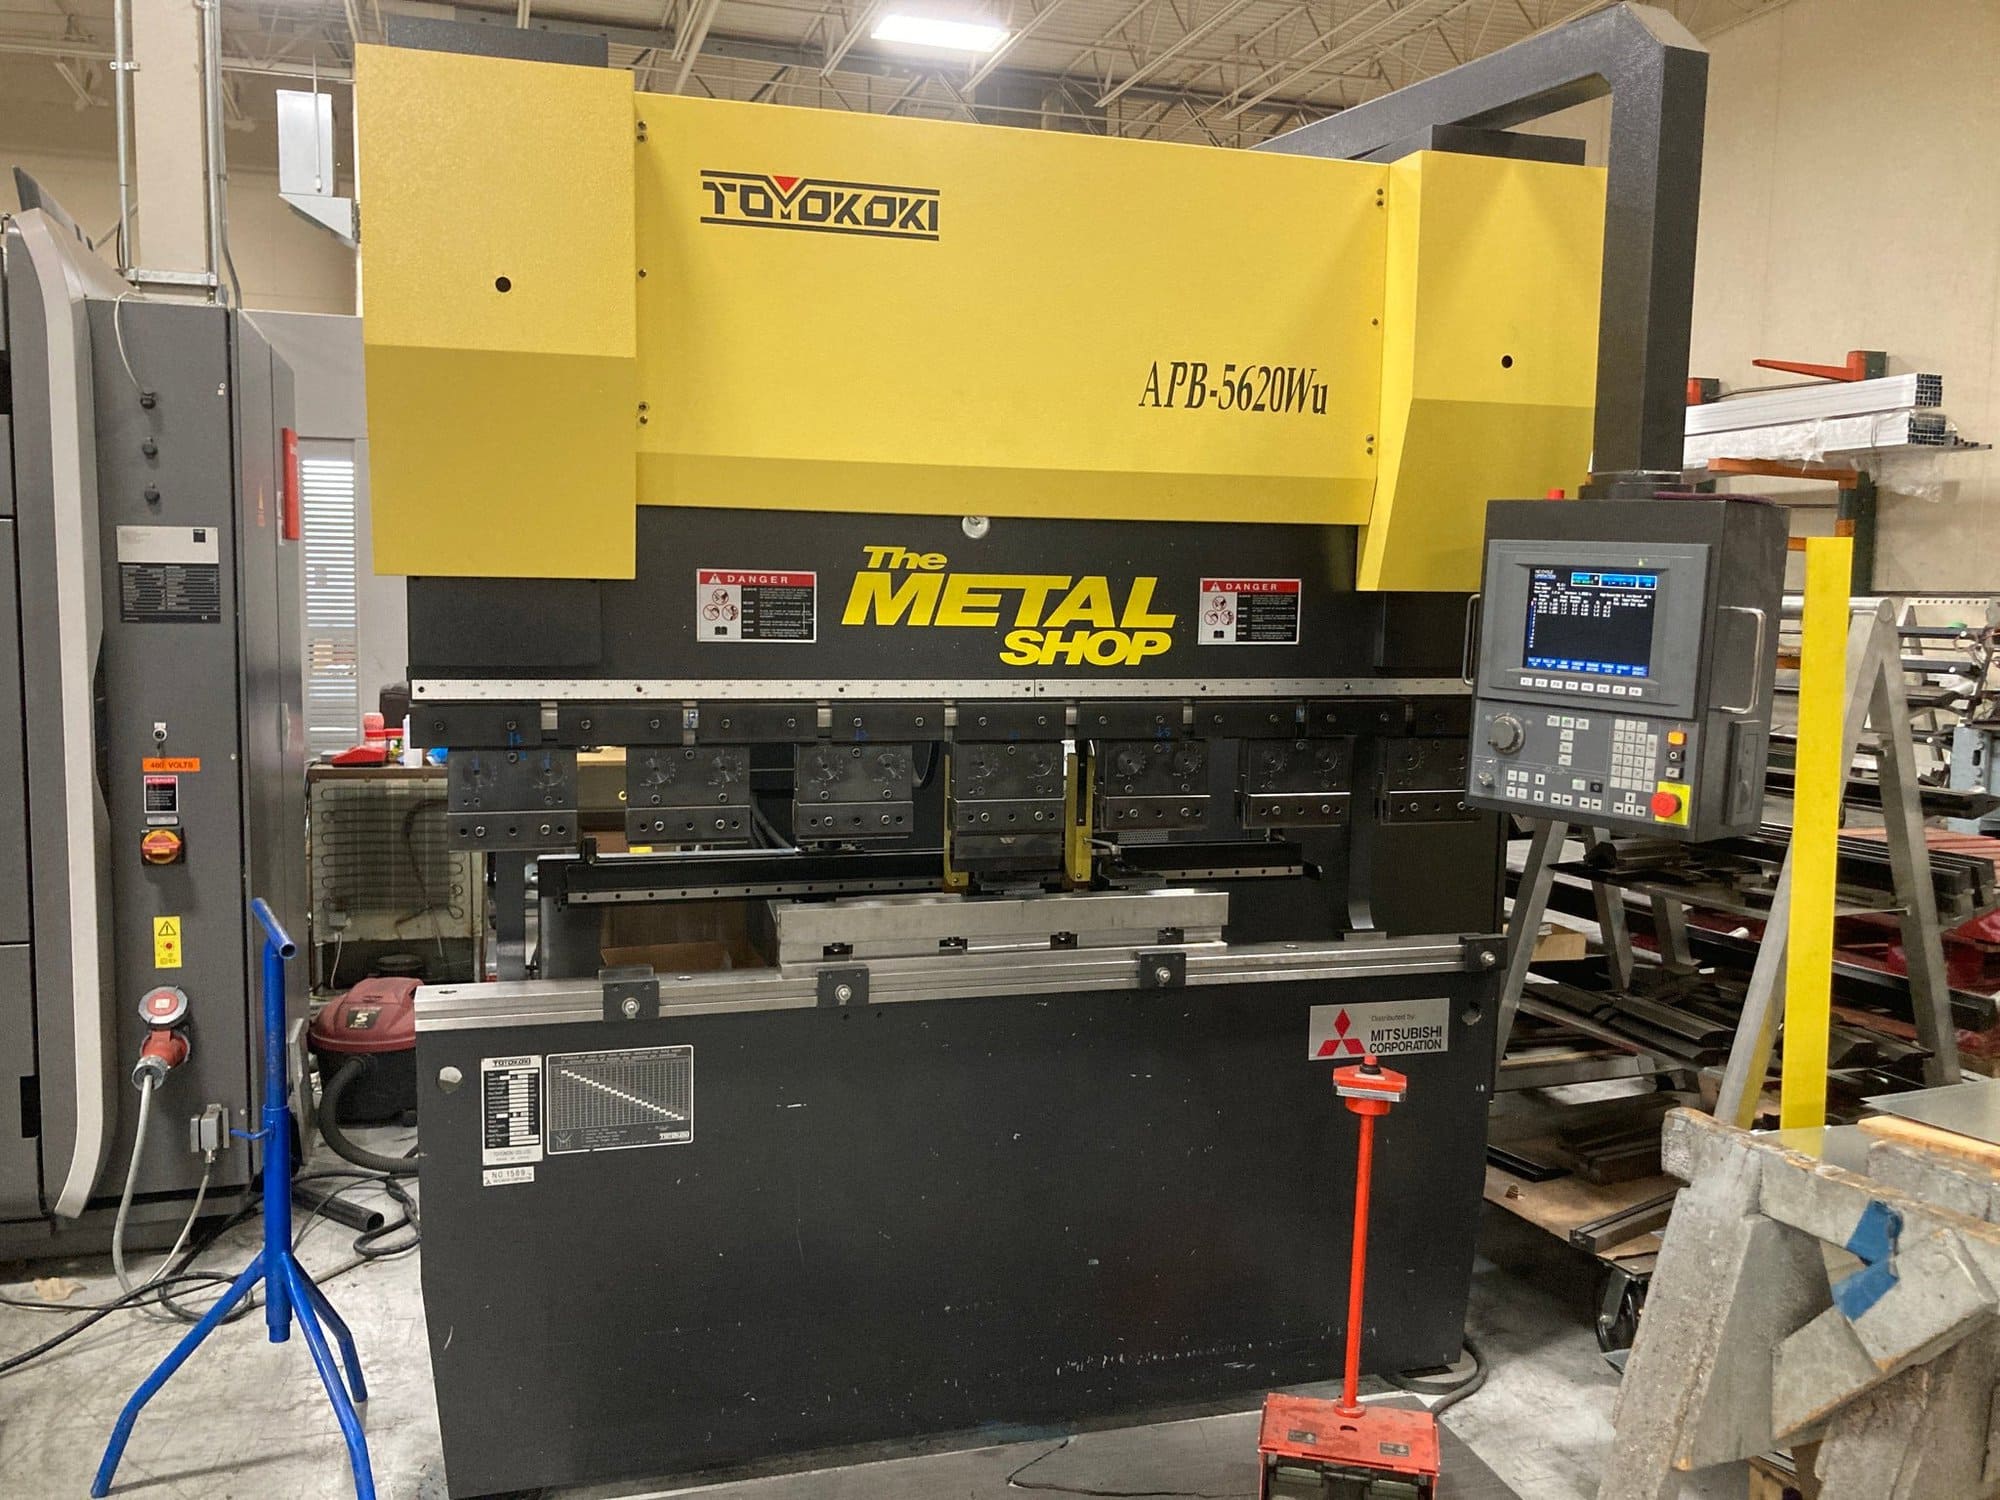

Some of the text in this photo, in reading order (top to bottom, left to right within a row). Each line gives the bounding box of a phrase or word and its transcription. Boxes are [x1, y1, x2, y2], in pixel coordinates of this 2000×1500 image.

[702, 175, 939, 232] TOYOKOKI
[1138, 360, 1328, 415] APB-5620Wu
[863, 545, 948, 570] The
[727, 574, 788, 584] DANGER
[1225, 583, 1278, 591] DANGER
[840, 571, 1177, 629] METAL
[999, 629, 1172, 666] SHOP
[168, 761, 194, 769] VOLTS
[1370, 1025, 1442, 1041] MITSUBISHI
[1369, 1038, 1442, 1054] CORPORATION
